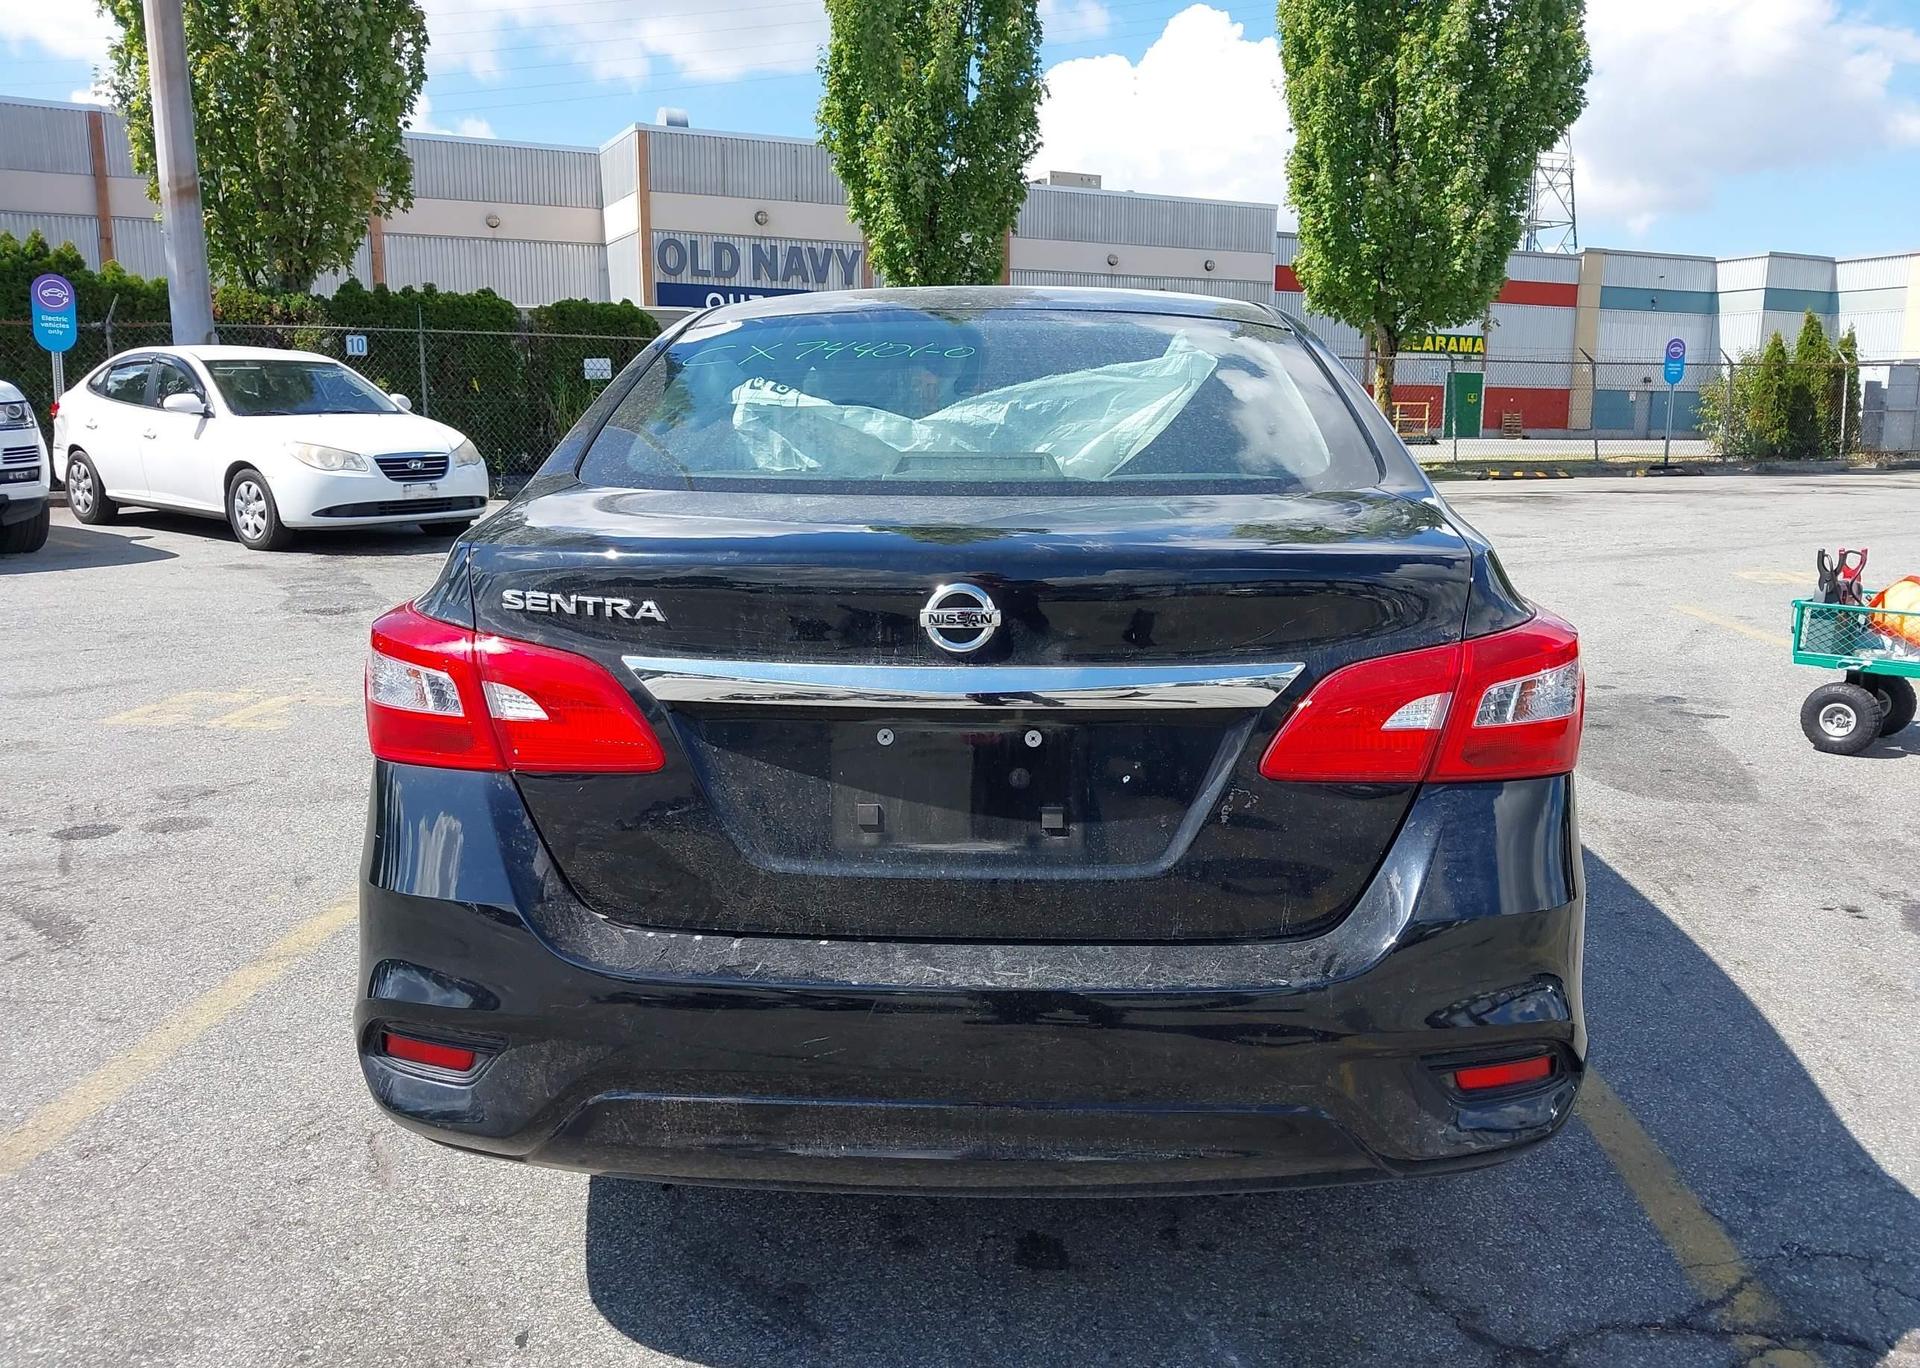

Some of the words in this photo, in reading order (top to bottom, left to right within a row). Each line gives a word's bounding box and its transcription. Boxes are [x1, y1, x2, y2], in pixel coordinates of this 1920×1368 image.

[657, 237, 741, 279] OLD
[751, 243, 862, 286] NAVY
[41, 314, 69, 323] Electric
[40, 321, 70, 329] vehicles
[47, 328, 64, 336] only
[348, 336, 365, 353] 10
[501, 588, 669, 623] SENTRA
[928, 613, 993, 625] NISSAN
